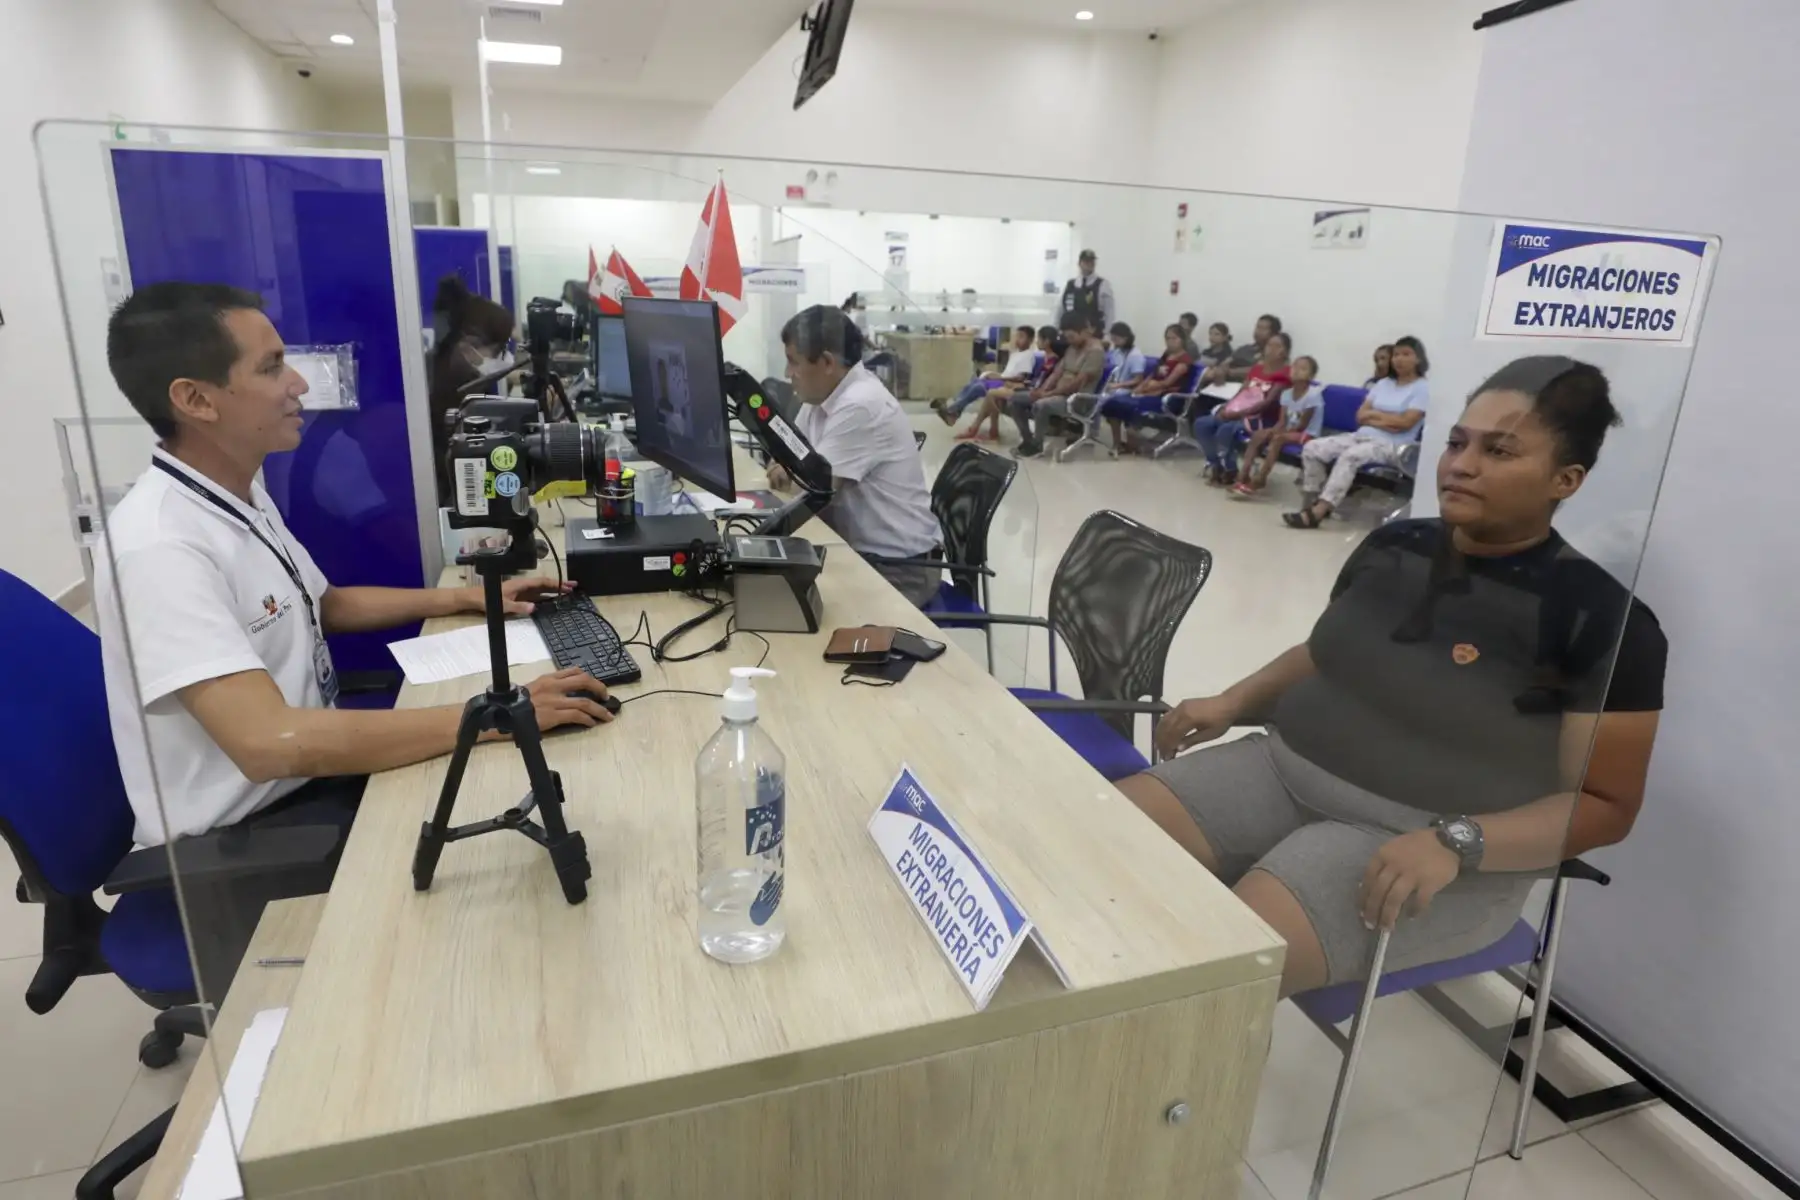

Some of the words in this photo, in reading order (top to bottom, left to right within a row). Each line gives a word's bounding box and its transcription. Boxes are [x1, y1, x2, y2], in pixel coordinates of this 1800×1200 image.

[1519, 234, 1551, 248] mac
[1528, 263, 1680, 295] MIGRACIONES
[1514, 302, 1676, 331] EXTRANJEROS
[905, 784, 927, 813] mac
[908, 822, 1004, 959] MIGRACIONES
[896, 849, 982, 985] EXTRANJERÍA
